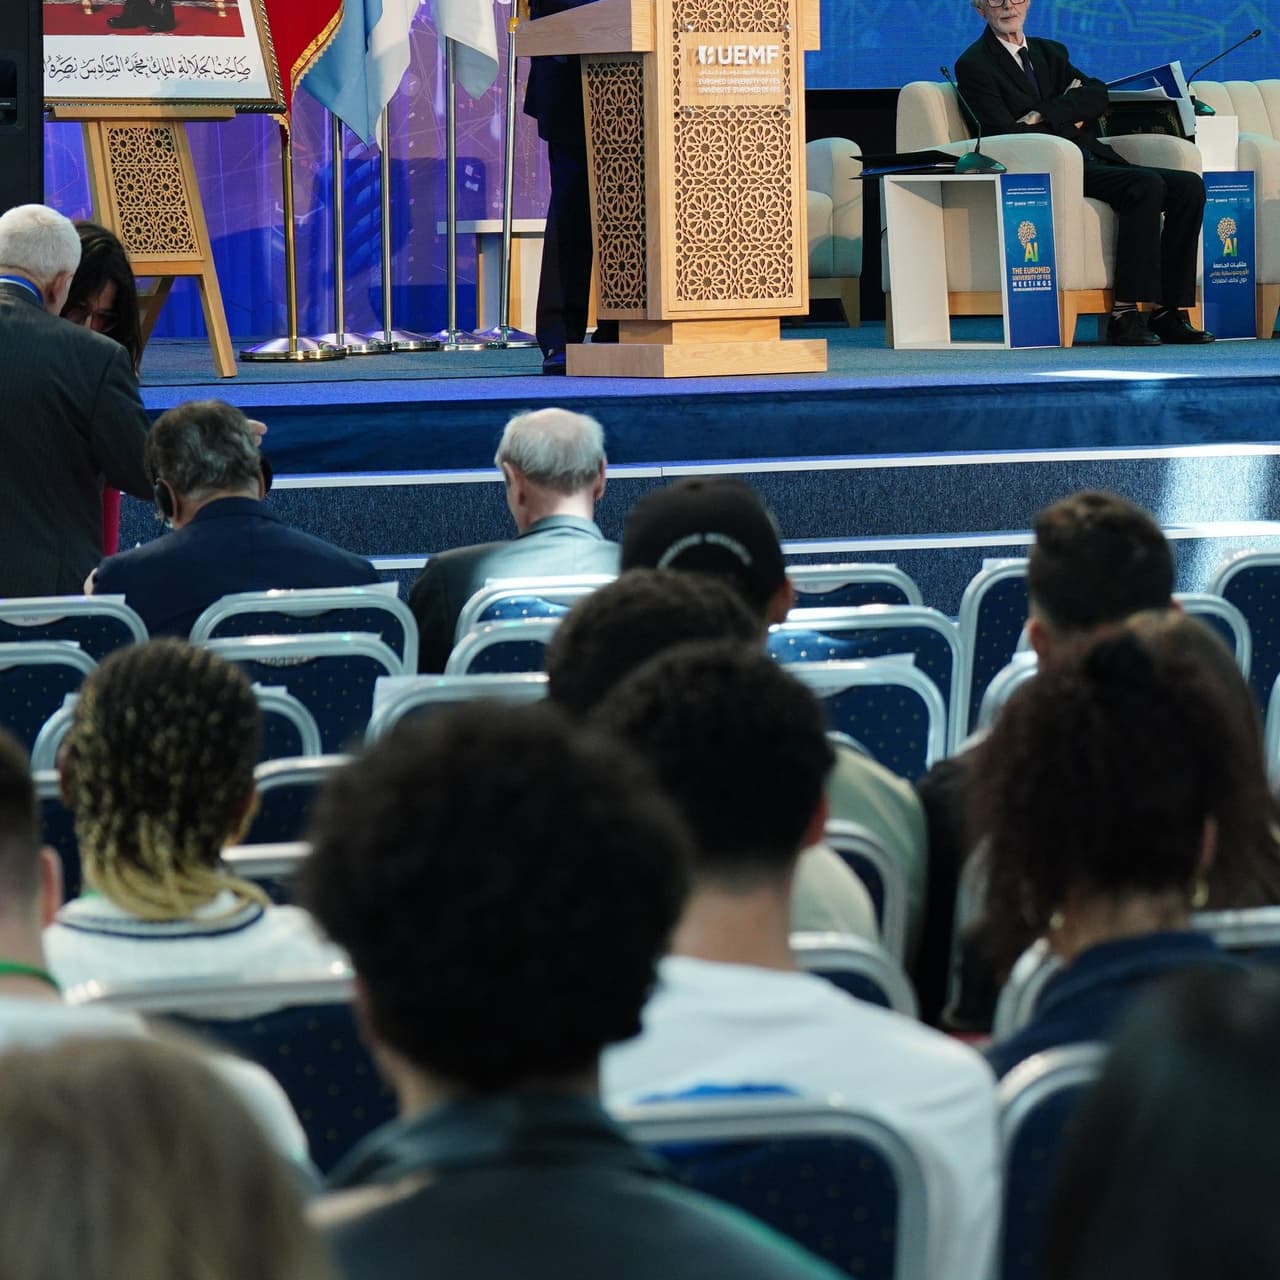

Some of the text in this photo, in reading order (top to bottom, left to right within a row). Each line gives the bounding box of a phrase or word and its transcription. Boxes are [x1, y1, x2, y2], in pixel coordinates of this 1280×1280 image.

[718, 45, 779, 65] UEMF
[1024, 241, 1039, 263] AI
[1222, 237, 1238, 257] AI
